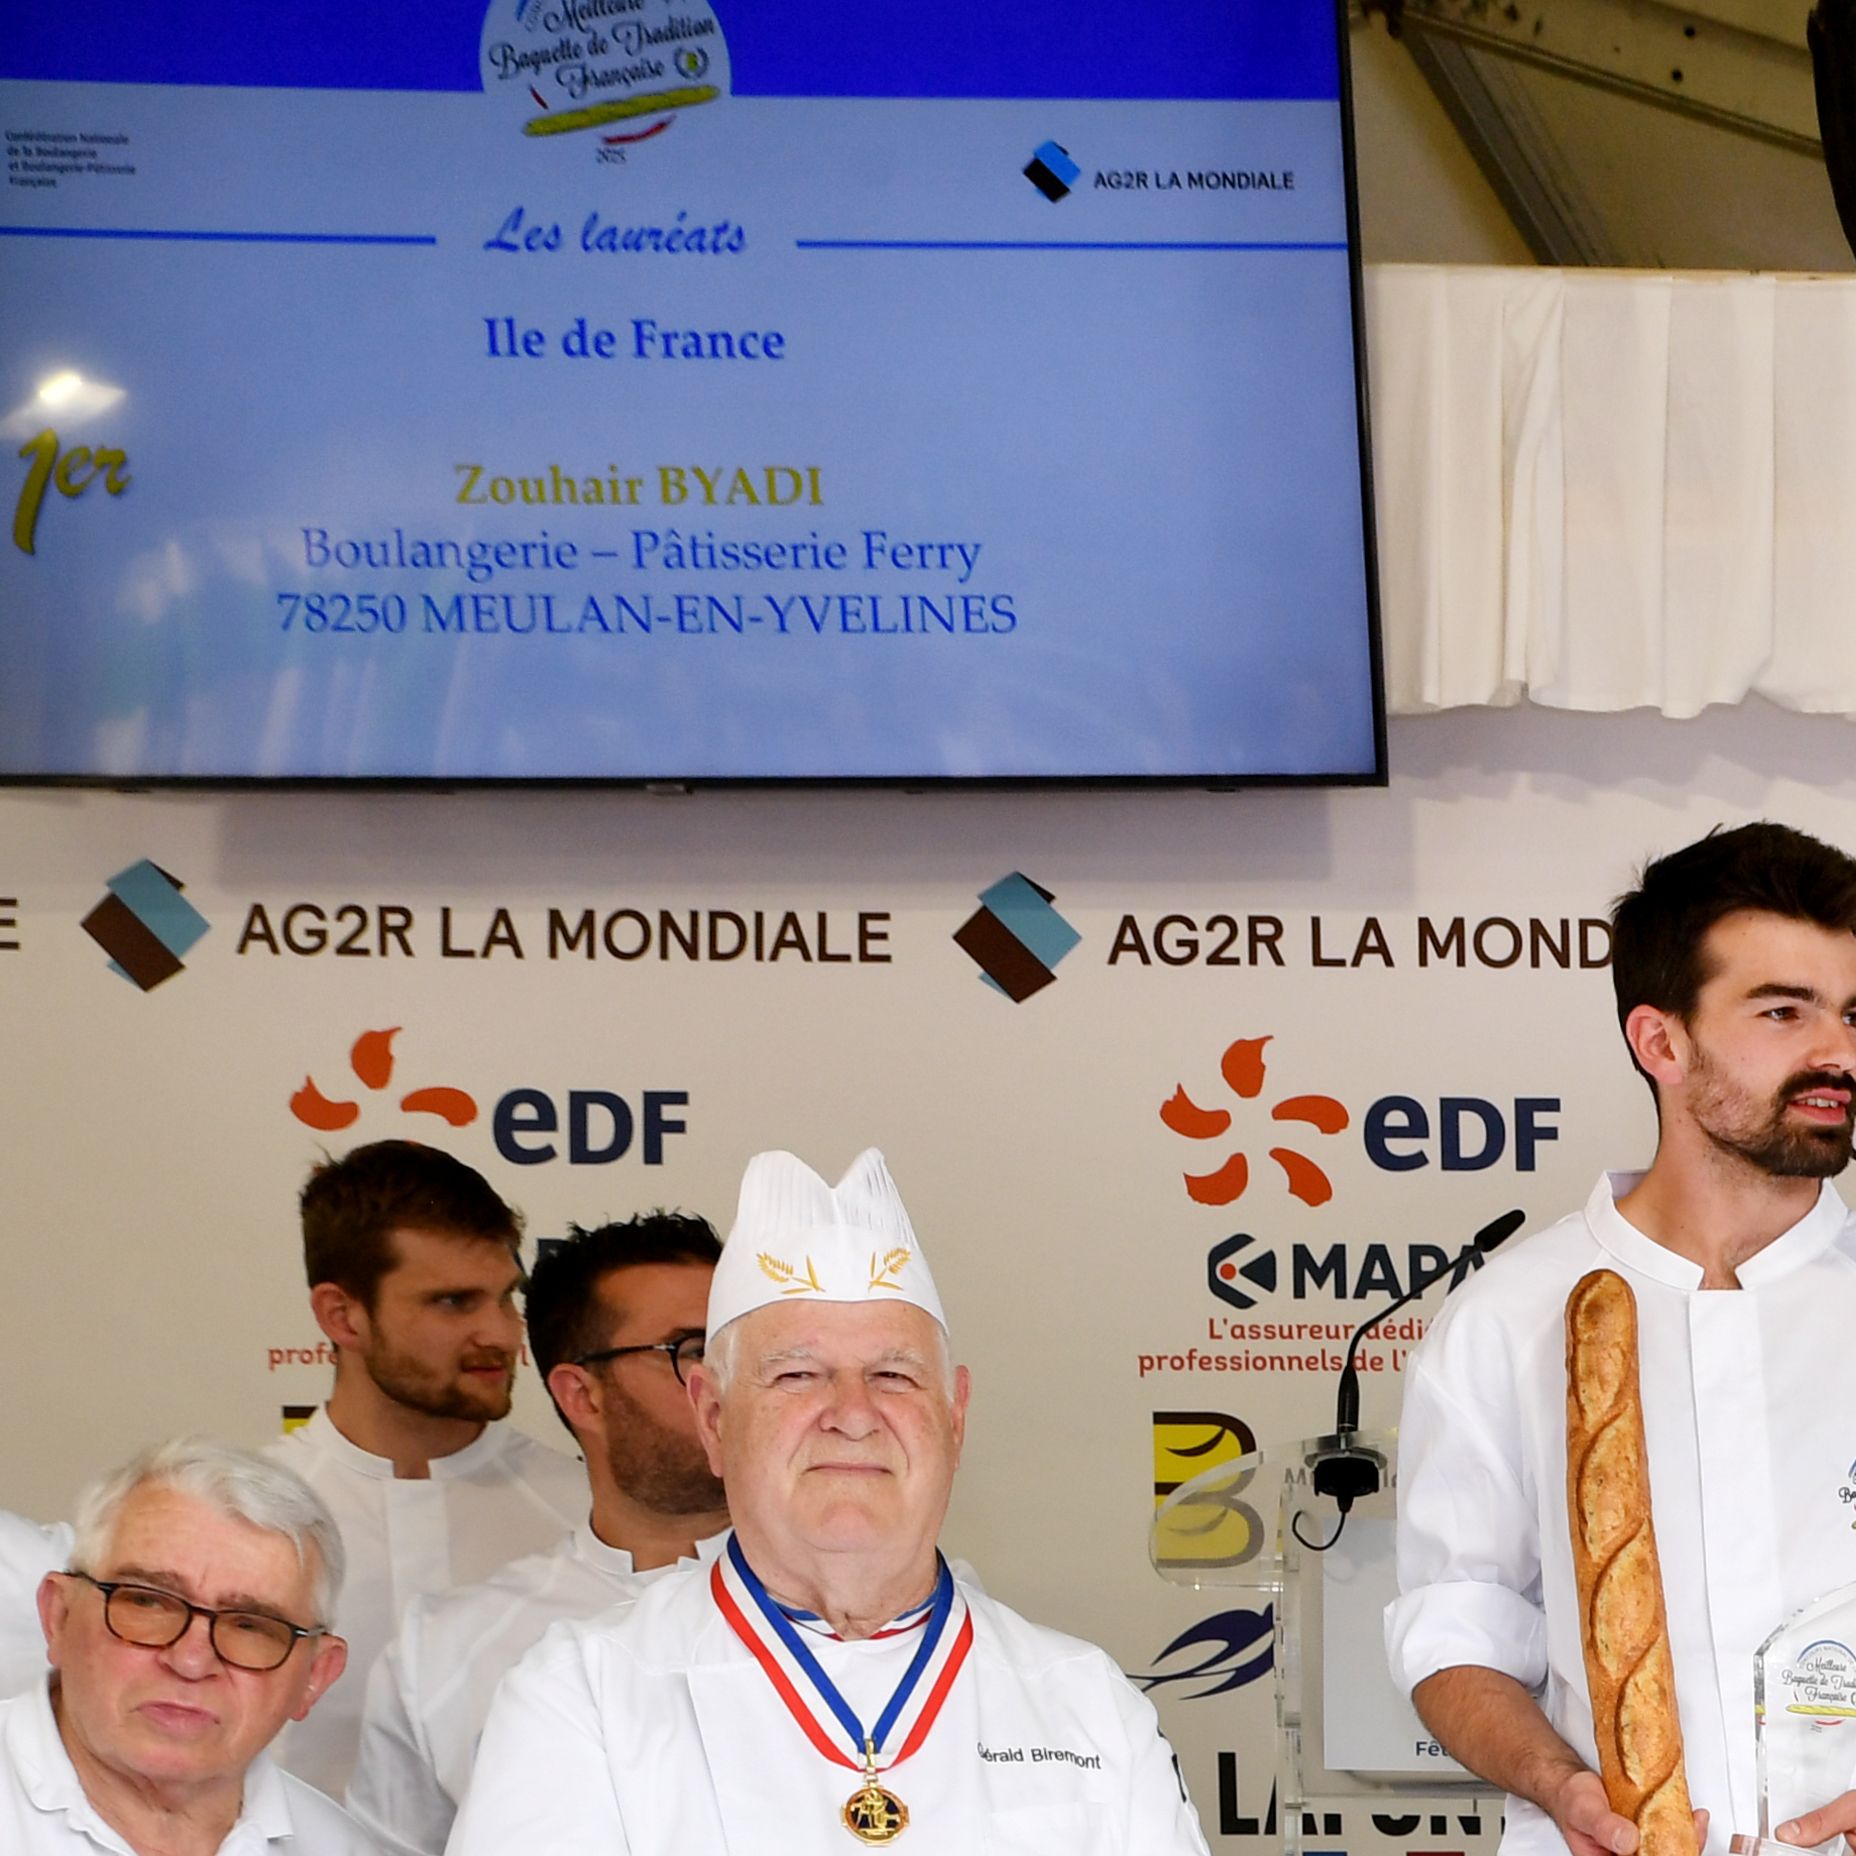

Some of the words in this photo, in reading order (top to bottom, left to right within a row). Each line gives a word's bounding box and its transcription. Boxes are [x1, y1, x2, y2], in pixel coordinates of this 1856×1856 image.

[1094, 171, 1148, 190] AG2R
[1155, 171, 1182, 190] LA
[1188, 171, 1295, 190] MONDIALE
[483, 206, 563, 255] Les
[583, 209, 747, 256] lauréats
[485, 318, 545, 358] Ile
[561, 318, 616, 360] de
[631, 320, 786, 361] France
[12, 427, 133, 556] 1er
[454, 465, 644, 507] Zouhair
[658, 467, 824, 507] BYADI
[302, 528, 578, 582] Boulangerie
[632, 528, 848, 572] Pâtisserie
[862, 532, 982, 583] Ferry
[277, 592, 407, 633] 78250
[420, 593, 1018, 636] MEULAN-EN-YVELINES
[237, 903, 413, 958] AG2R
[440, 906, 524, 960] LA
[547, 908, 893, 963] MONDIALE
[1107, 914, 1286, 966] AG2R
[1311, 916, 1395, 968] LA
[1418, 917, 1614, 969] MOND
[1292, 1243, 1486, 1300] MAPA
[1208, 1317, 1355, 1341] L'assureur
[1364, 1316, 1432, 1341] dédi
[1139, 1348, 1344, 1377] professionnels
[1352, 1349, 1384, 1373] de
[1030, 1748, 1101, 1770] Biremont
[1416, 1741, 1450, 1756] Fêt
